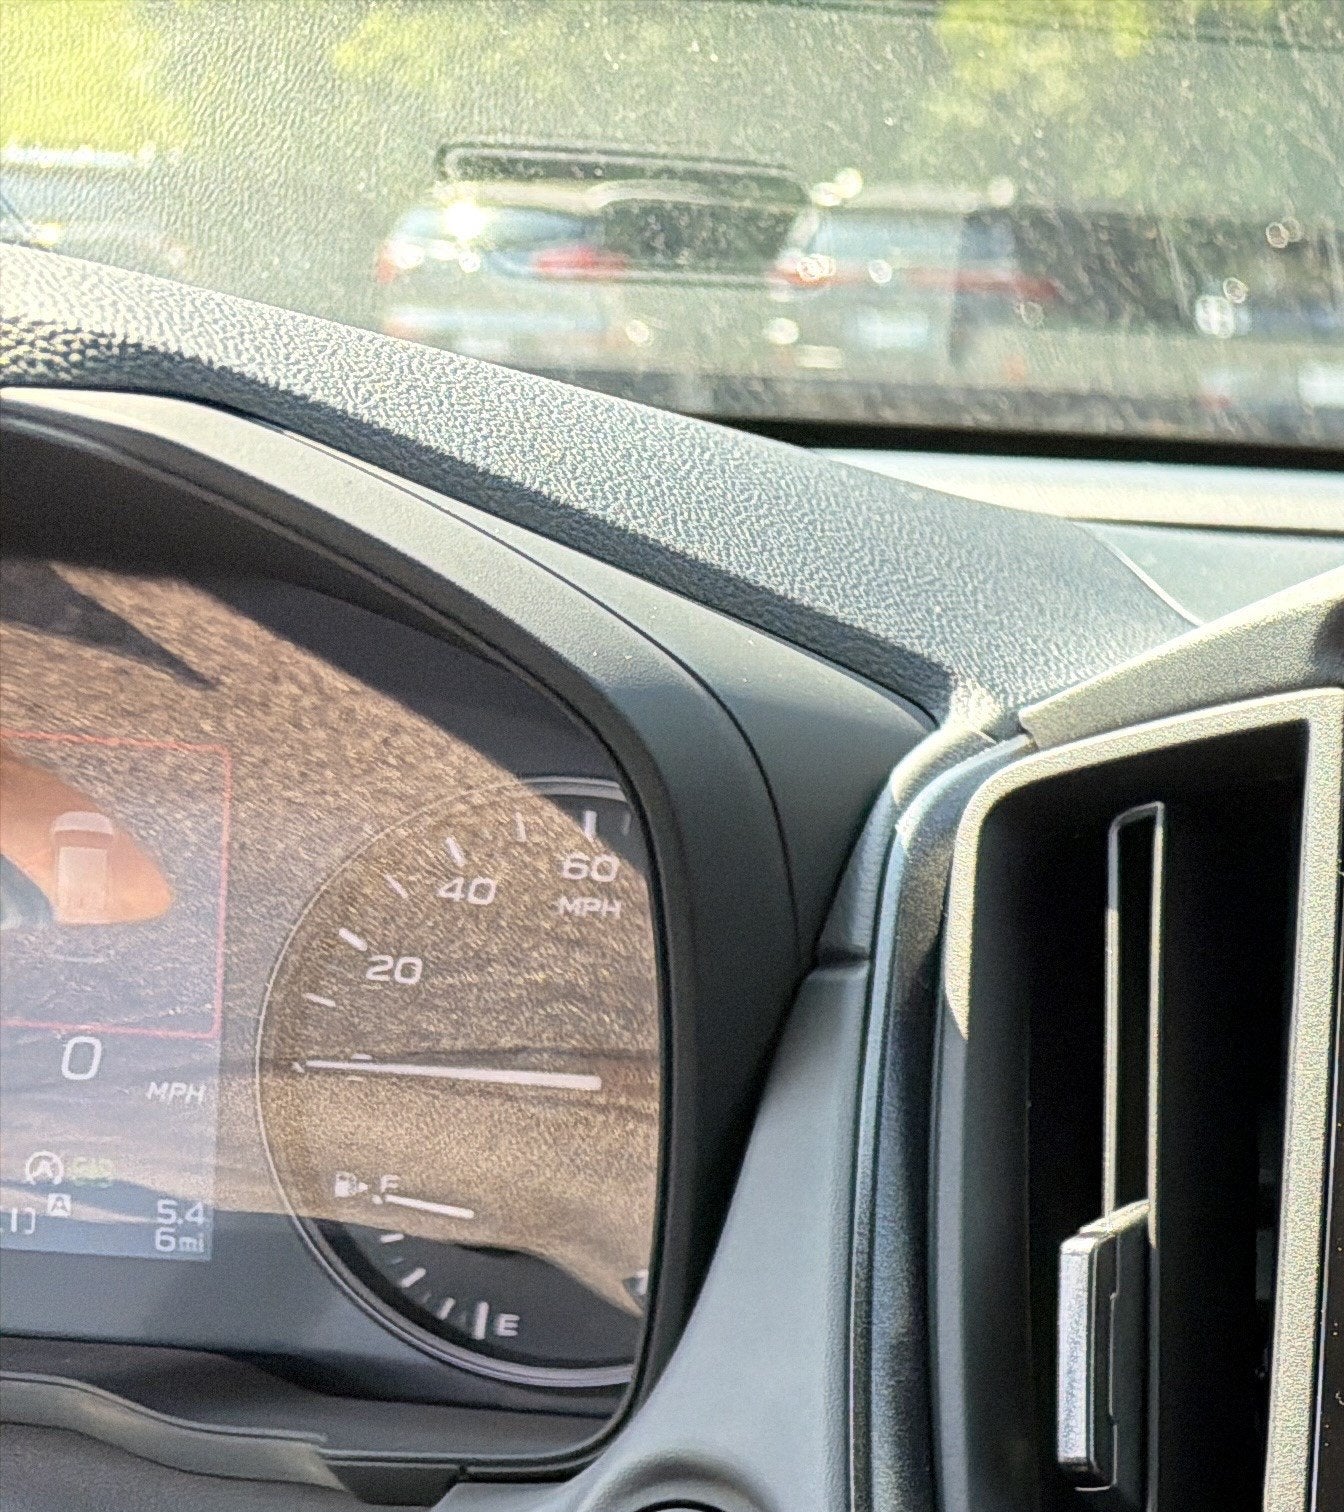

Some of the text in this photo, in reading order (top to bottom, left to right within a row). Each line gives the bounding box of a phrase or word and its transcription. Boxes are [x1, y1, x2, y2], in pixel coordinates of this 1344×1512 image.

[562, 853, 619, 882] 60
[437, 876, 497, 905] 40
[558, 897, 621, 918] MPH
[366, 955, 422, 985] 20
[61, 1036, 101, 1080] 0
[147, 1082, 206, 1104] MPH
[495, 1313, 520, 1337] E
